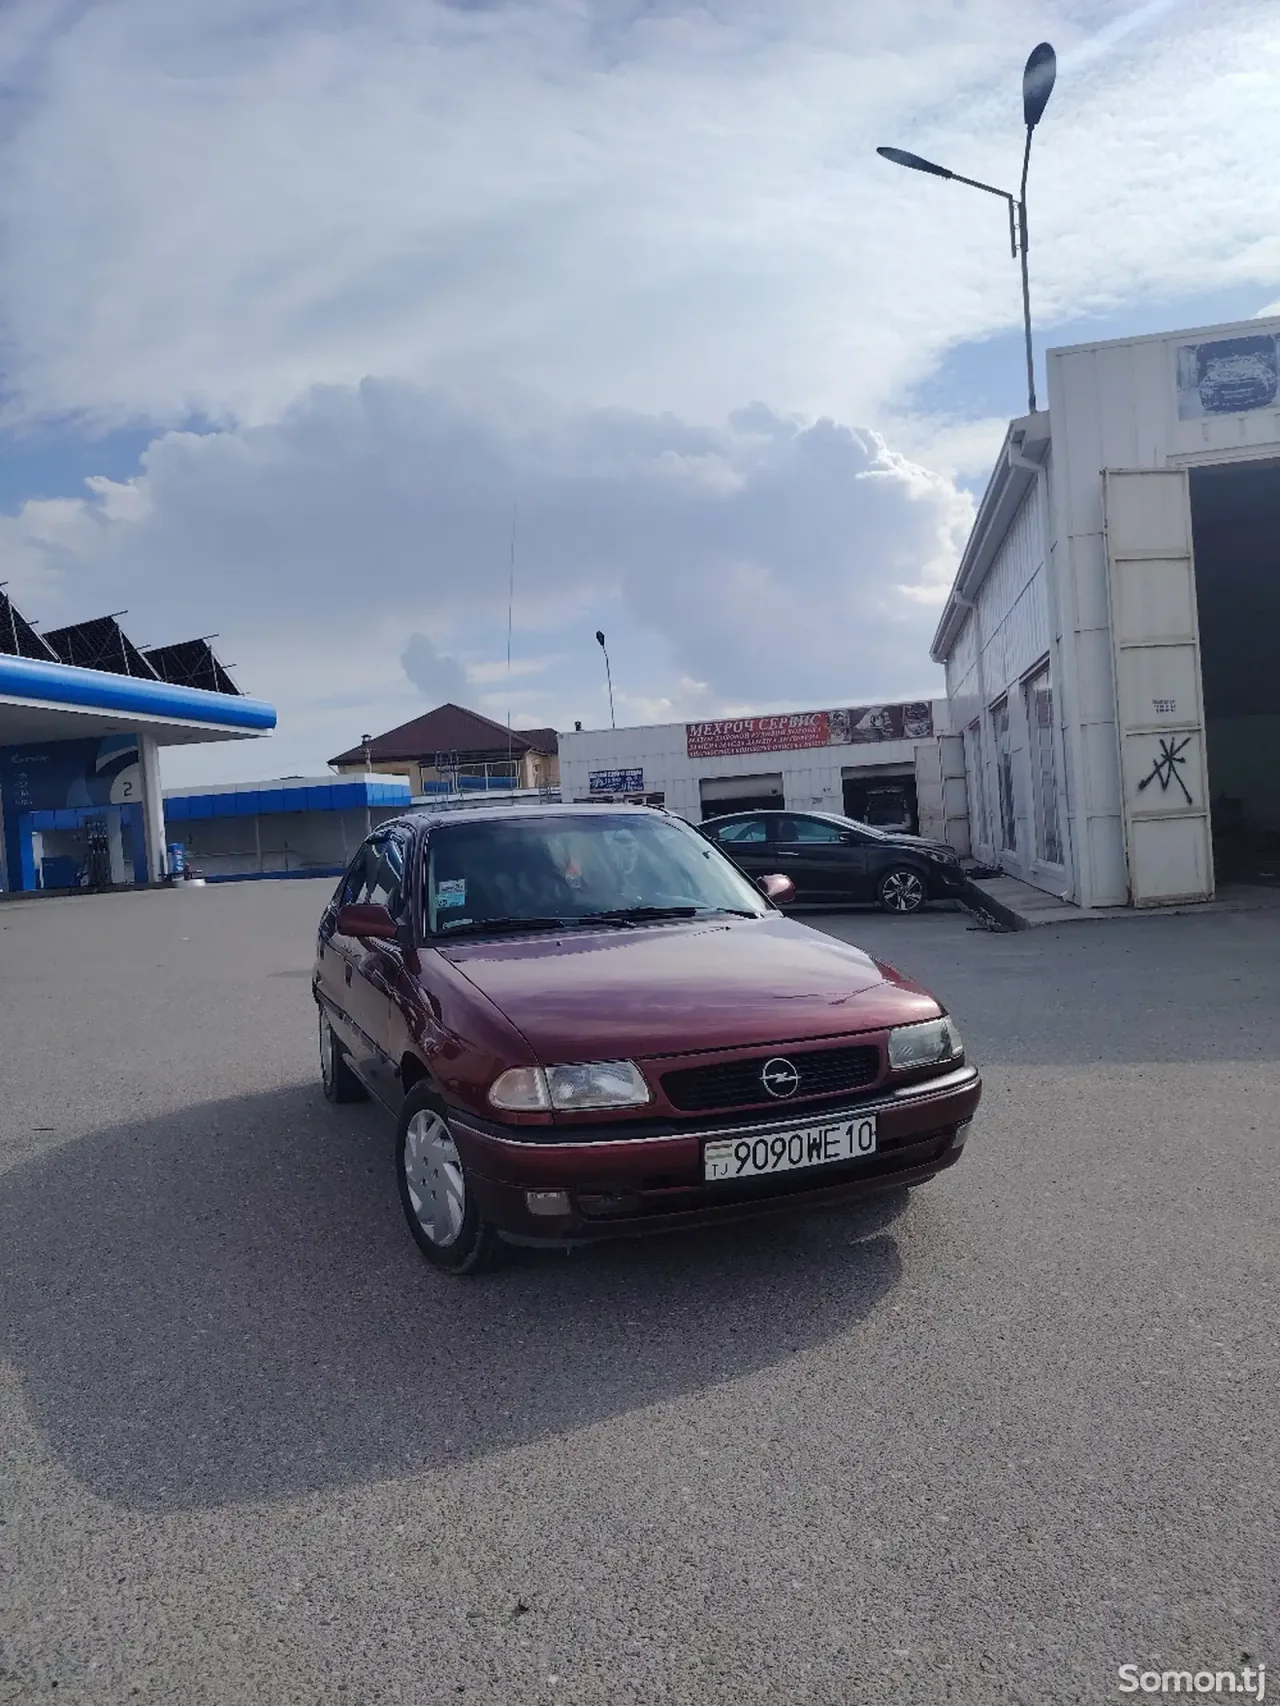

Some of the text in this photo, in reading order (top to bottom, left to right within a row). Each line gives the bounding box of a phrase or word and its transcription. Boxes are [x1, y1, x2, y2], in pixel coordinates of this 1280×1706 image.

[759, 714, 821, 730] СЕРВИС
[123, 781, 133, 797] 2
[711, 1163, 728, 1176] TJ
